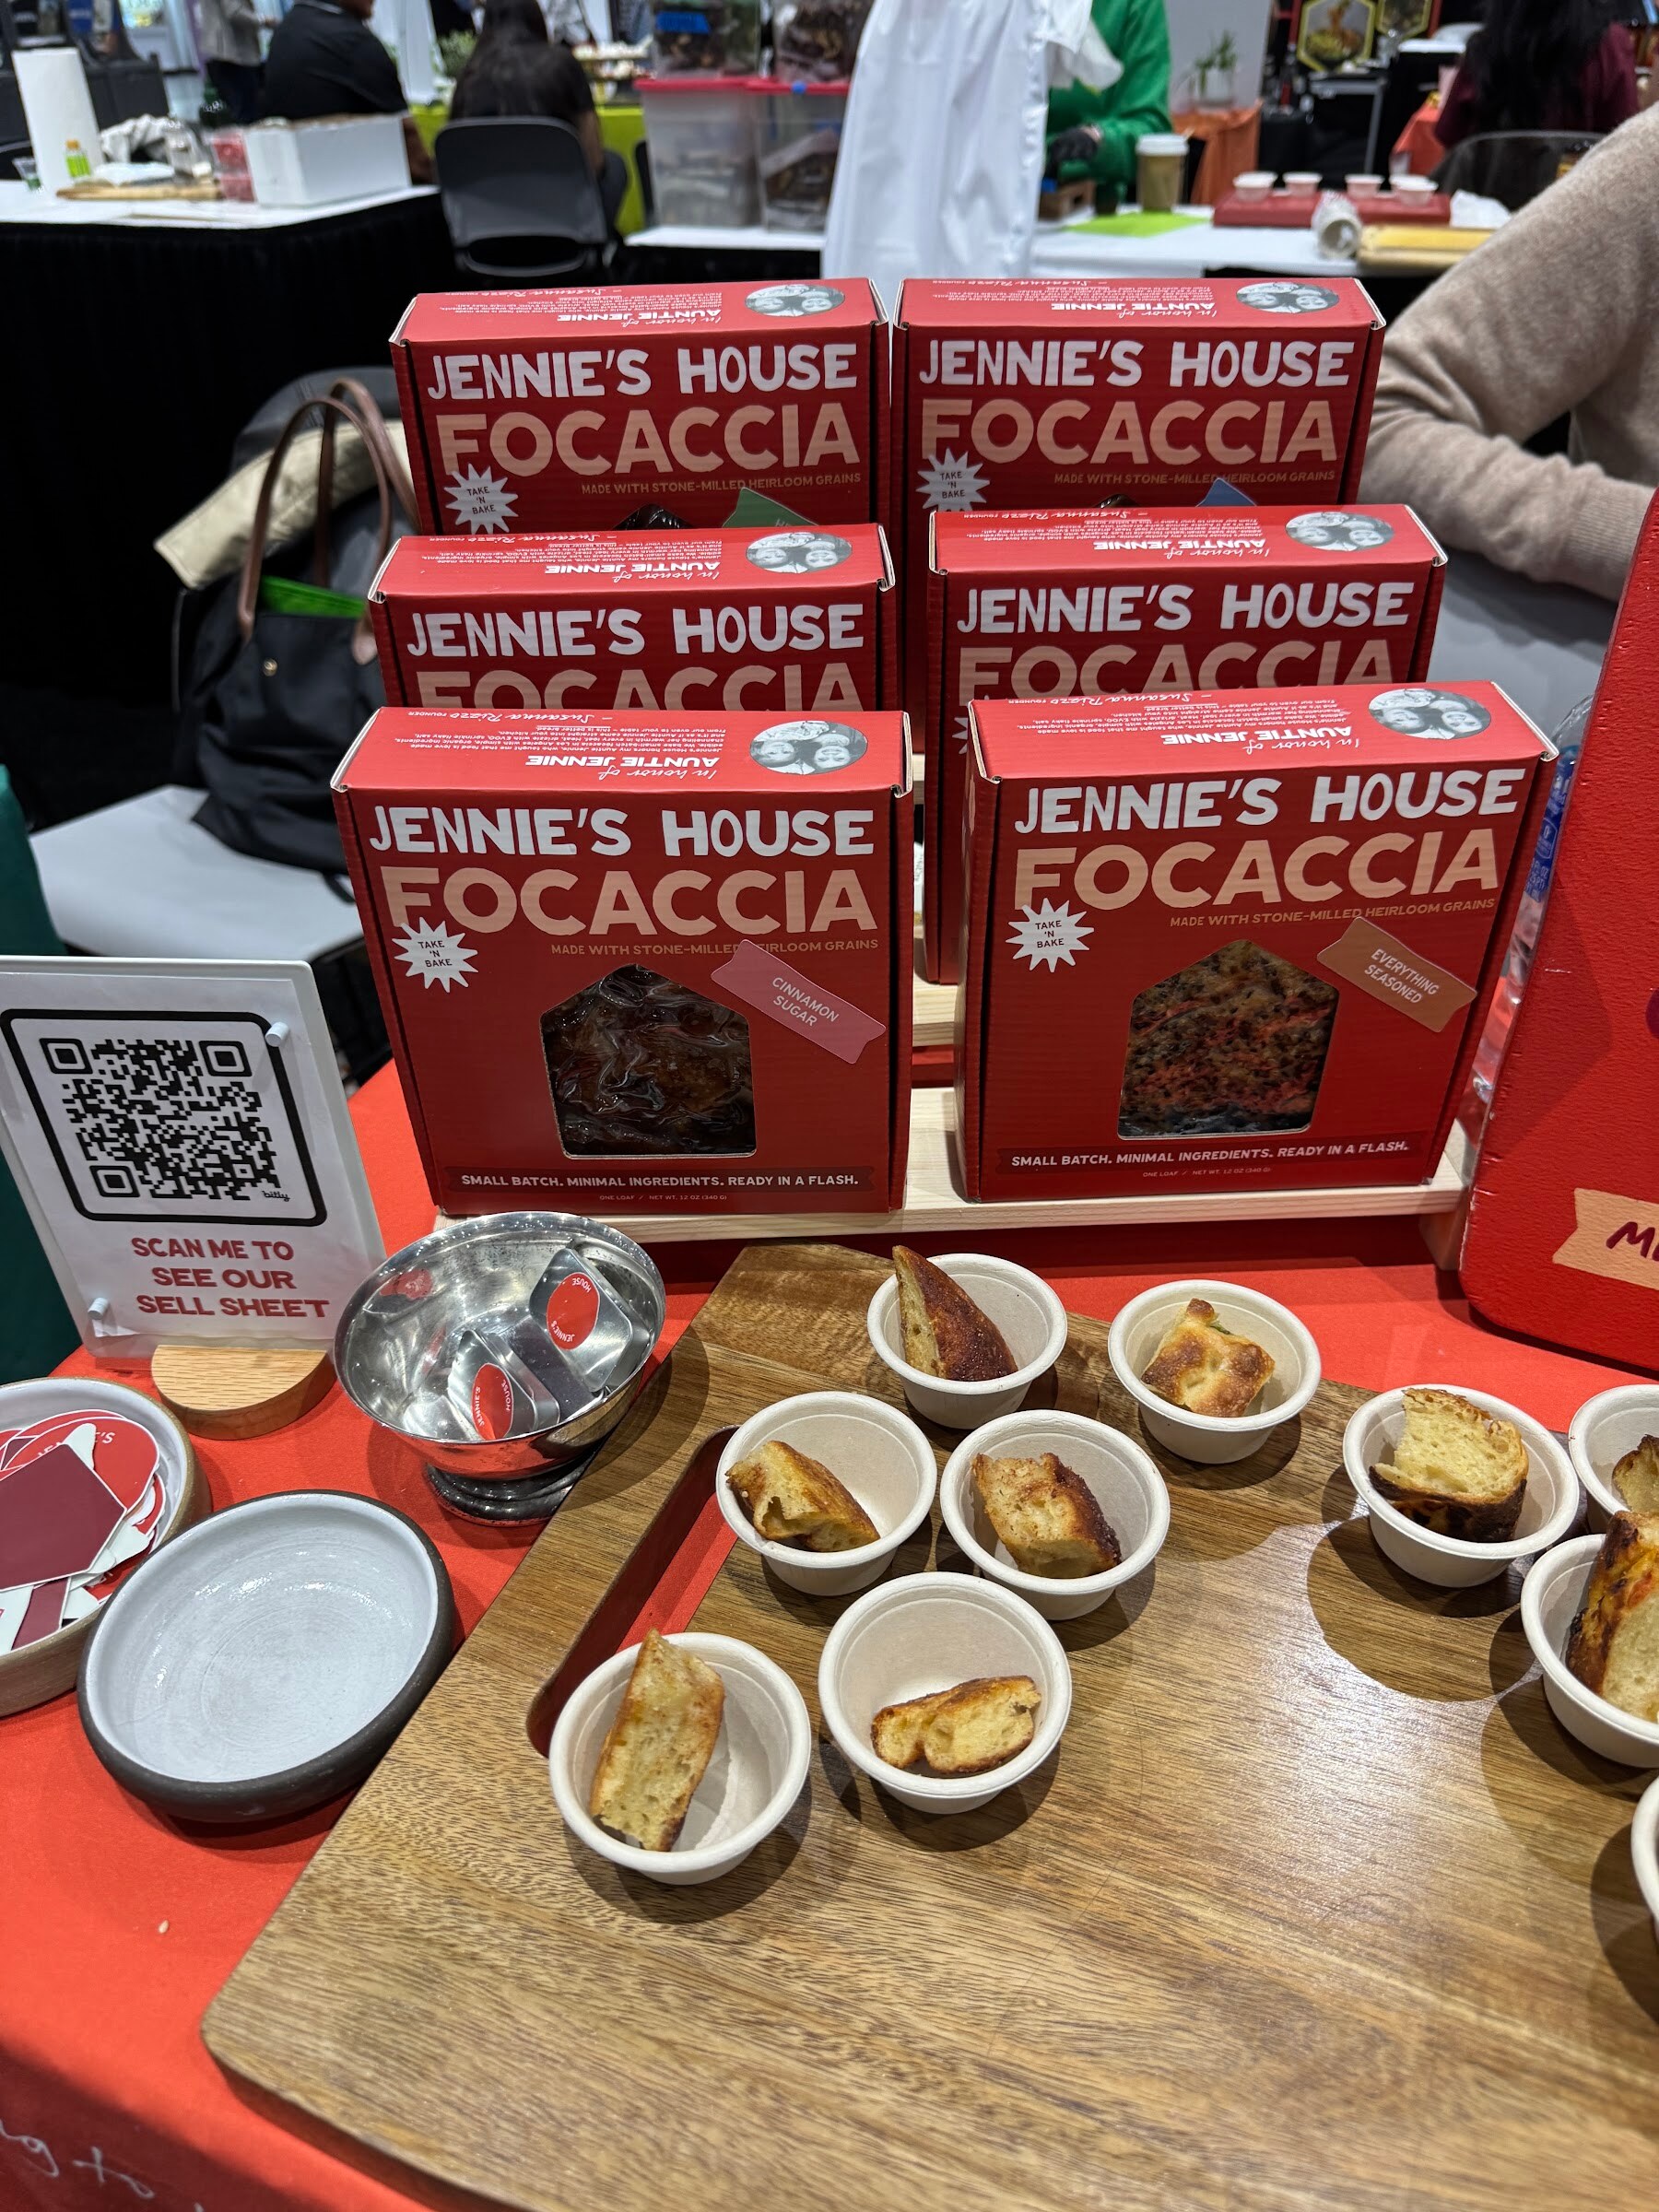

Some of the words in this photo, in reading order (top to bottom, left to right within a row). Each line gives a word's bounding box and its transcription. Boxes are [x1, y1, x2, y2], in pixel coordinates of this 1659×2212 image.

[1131, 302, 1215, 311] AUNTIE
[557, 312, 632, 321] JENNIE
[639, 310, 721, 320] AUNTIE
[428, 348, 652, 400] JENNIE'S
[678, 344, 857, 394] HOUSE
[919, 340, 1144, 387] JENNIE'S
[1170, 341, 1355, 388] HOUSE
[922, 398, 1337, 465] FOCACCIA
[436, 402, 860, 478] FOCACCIA
[940, 471, 963, 480] TAKE
[1054, 473, 1084, 484] MADE
[1087, 473, 1122, 484] WITH
[1289, 470, 1335, 482] GRAINS
[466, 486, 490, 496] TAKE
[582, 482, 611, 495] MADE
[614, 480, 649, 494] WITH
[652, 479, 747, 494] STONE-MILLED
[748, 476, 813, 490] HEIRLOOM
[816, 473, 861, 486] GRAINS
[942, 489, 965, 499] BAKE
[472, 504, 496, 515] BAKE
[1094, 541, 1172, 550] JENNIE
[1178, 539, 1265, 549] AUNTIE
[546, 564, 626, 573] JENNIE
[631, 561, 720, 572] AUNTIE
[957, 582, 1194, 633] JENNIE'S
[1220, 582, 1415, 629] HOUSE
[406, 608, 645, 657] JENNIE'S
[672, 604, 864, 654] HOUSE
[959, 639, 1394, 705] FOCACCIA
[416, 662, 865, 711] FOCACCIA
[1104, 693, 1194, 705] Susanna
[508, 713, 594, 724] Susanna
[1161, 731, 1248, 745] JENNIE
[1254, 726, 1351, 741] AUNTIE
[1242, 739, 1264, 755] of
[1272, 739, 1330, 749] honor
[1335, 738, 1359, 748] In
[525, 755, 616, 767] JENNIE
[623, 757, 720, 767] AUNTIE
[598, 765, 620, 781] of
[627, 770, 688, 779] honor
[694, 770, 717, 780] In
[1015, 777, 1282, 834] JENNIE'S
[1310, 769, 1525, 823] HOUSE
[370, 806, 631, 856] JENNIE'S
[662, 809, 874, 857] HOUSE
[1015, 828, 1499, 912] FOCACCIA
[380, 865, 877, 936] FOCACCIA
[1171, 916, 1205, 927] MADE
[1208, 914, 1250, 925] WITH
[1253, 908, 1363, 924] STONE-MILLED
[1365, 903, 1441, 917] HEIRLOOM
[1442, 898, 1495, 912] GRAINS
[1035, 920, 1062, 930] TAKE
[418, 940, 445, 949] TAKE
[551, 945, 583, 955] MADE
[588, 945, 629, 955] WITH
[757, 941, 824, 954] IRLOOM
[825, 939, 878, 951] GRAINS
[1036, 937, 1065, 948] BAKE
[425, 959, 453, 968] BAKE
[1370, 948, 1441, 997] EVERYTHING
[1364, 963, 1423, 1006] SEASONED
[772, 975, 840, 1024] CINNAMON
[773, 995, 818, 1030] SUGAR
[1011, 1156, 1058, 1167] SMALL
[1061, 1155, 1112, 1165] BATCH.
[1116, 1152, 1174, 1164] MINIMAL
[1178, 1148, 1274, 1162] INGREDIENTS.
[1277, 1146, 1324, 1158] READY
[1327, 1145, 1342, 1155] IN
[1345, 1144, 1355, 1154] A
[1359, 1141, 1408, 1153] FLASH.
[462, 1174, 509, 1186] SMALL
[512, 1176, 564, 1187] BATCH.
[567, 1177, 627, 1187] MINIMAL
[629, 1176, 724, 1186] INGREDIENTS.
[728, 1176, 773, 1186] READY
[778, 1176, 791, 1185] IN
[794, 1175, 805, 1185] A
[808, 1175, 858, 1185] FLASH.
[131, 1237, 206, 1258] SCAN
[207, 1239, 249, 1259] ME
[251, 1241, 294, 1261] TO
[151, 1267, 218, 1288] SEE
[222, 1269, 297, 1289] OUR
[571, 1277, 592, 1293] HOUSE
[136, 1295, 216, 1315] SELL
[219, 1298, 330, 1318] SHEET
[551, 1320, 575, 1342] JENNIE'S
[501, 1379, 512, 1412] HOUSE
[474, 1386, 485, 1427] JENNIE'S
